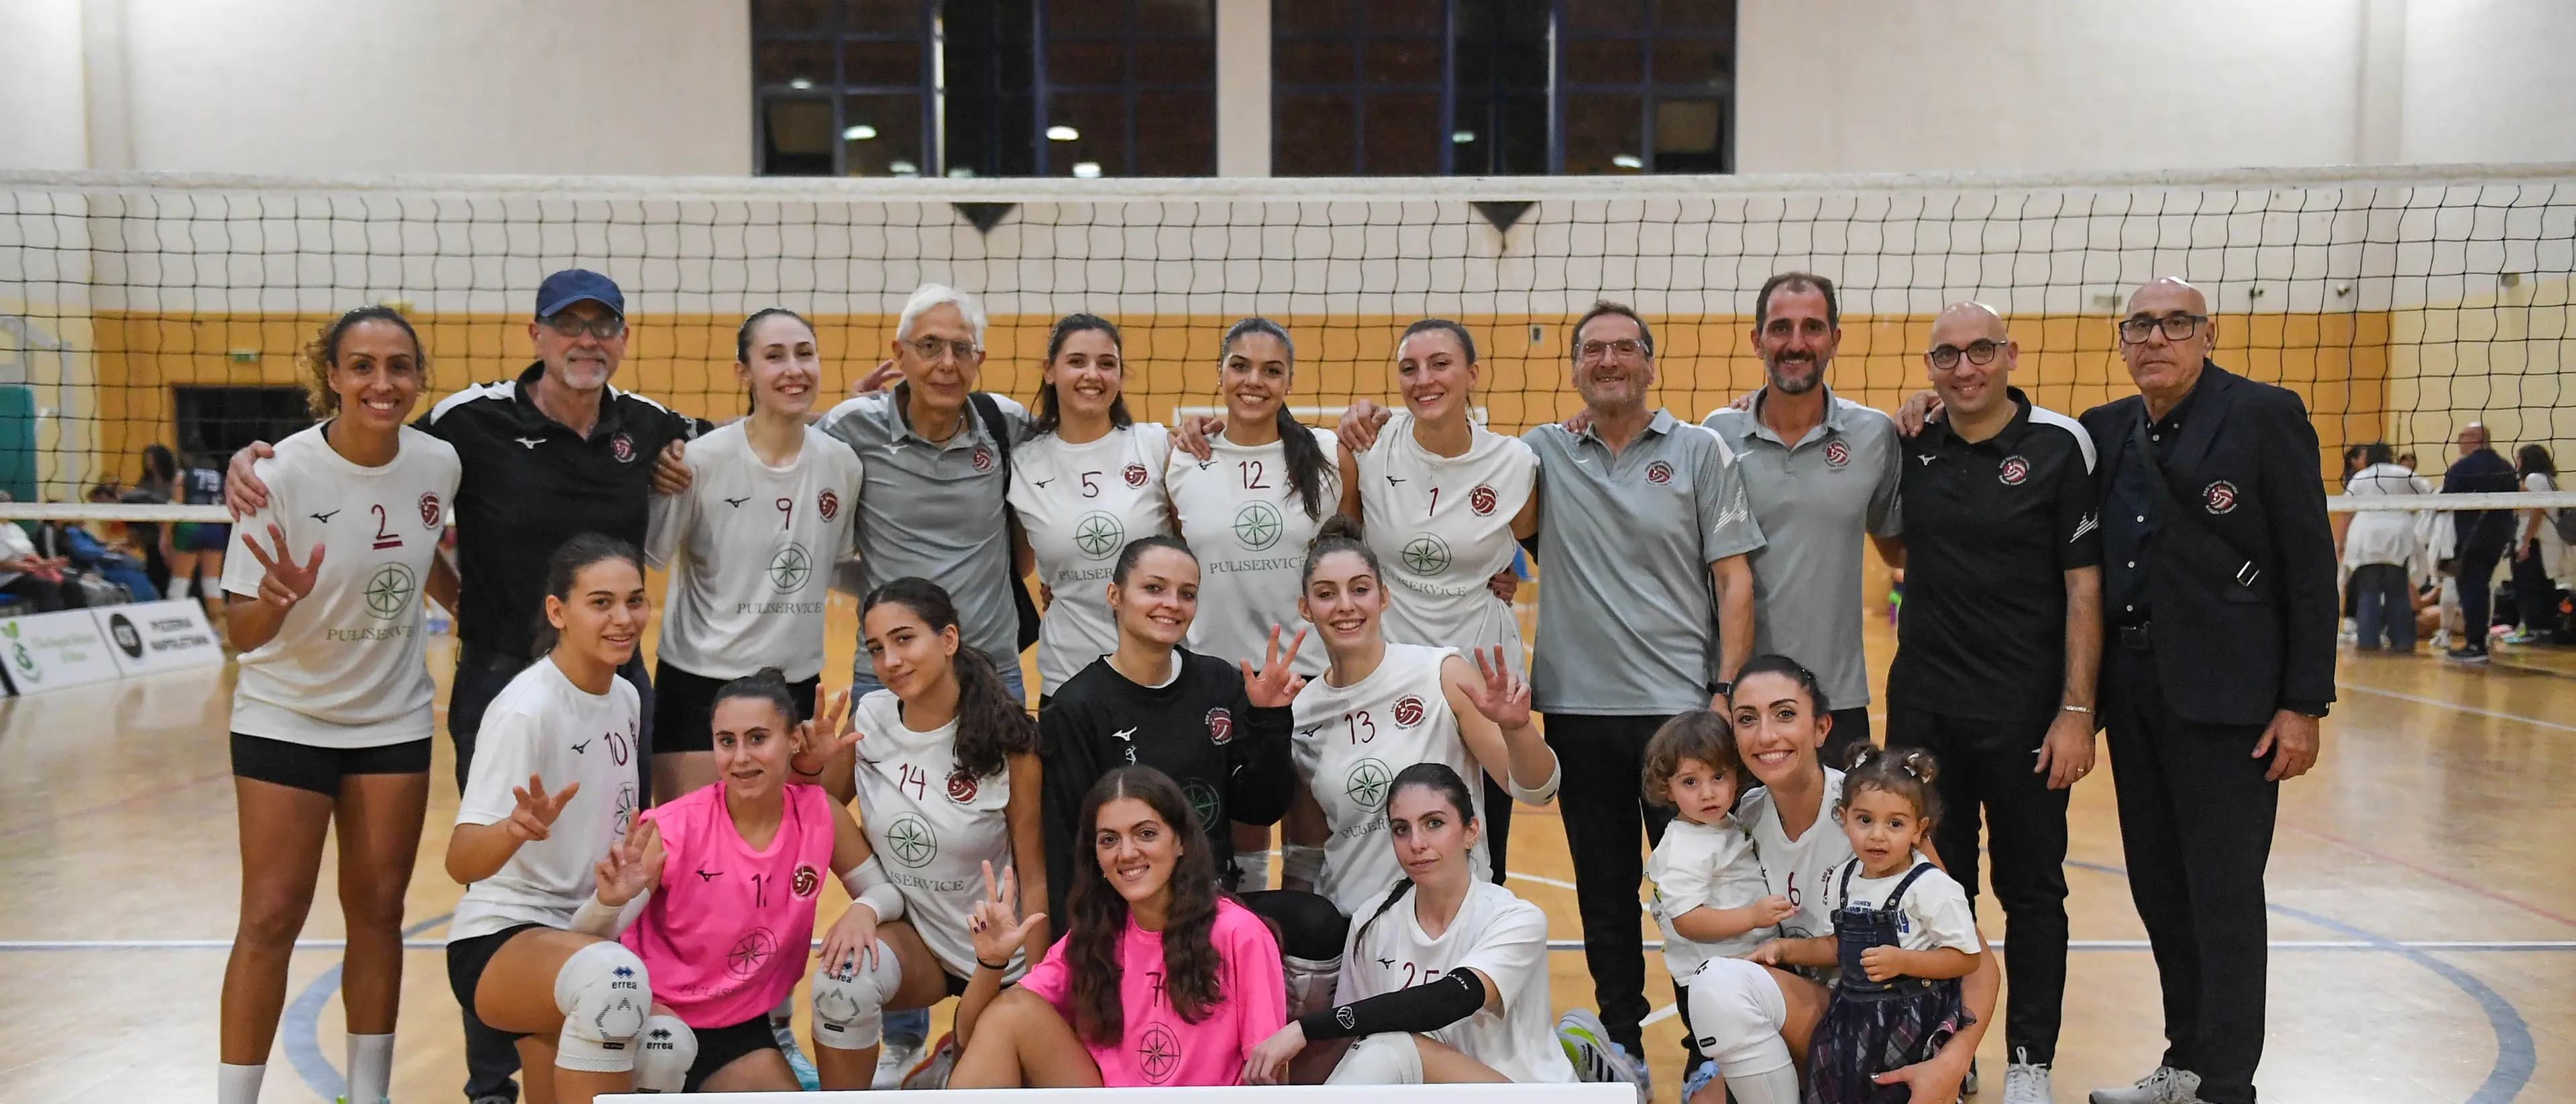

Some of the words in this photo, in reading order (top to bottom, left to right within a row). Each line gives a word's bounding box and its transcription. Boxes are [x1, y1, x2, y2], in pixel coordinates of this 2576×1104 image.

[1081, 471, 1102, 498] 5
[1238, 460, 1271, 489] 12
[776, 498, 792, 530] 9
[1430, 487, 1439, 517] 1
[371, 504, 400, 540] 2
[1210, 556, 1307, 574] PULISERVICE
[1345, 711, 1376, 745] 13
[604, 732, 628, 766] 10
[900, 763, 926, 801] 14
[1788, 871, 1801, 906] 6
[612, 981, 637, 989] errea
[1145, 971, 1163, 1008] 7
[646, 1042, 674, 1050] errea
